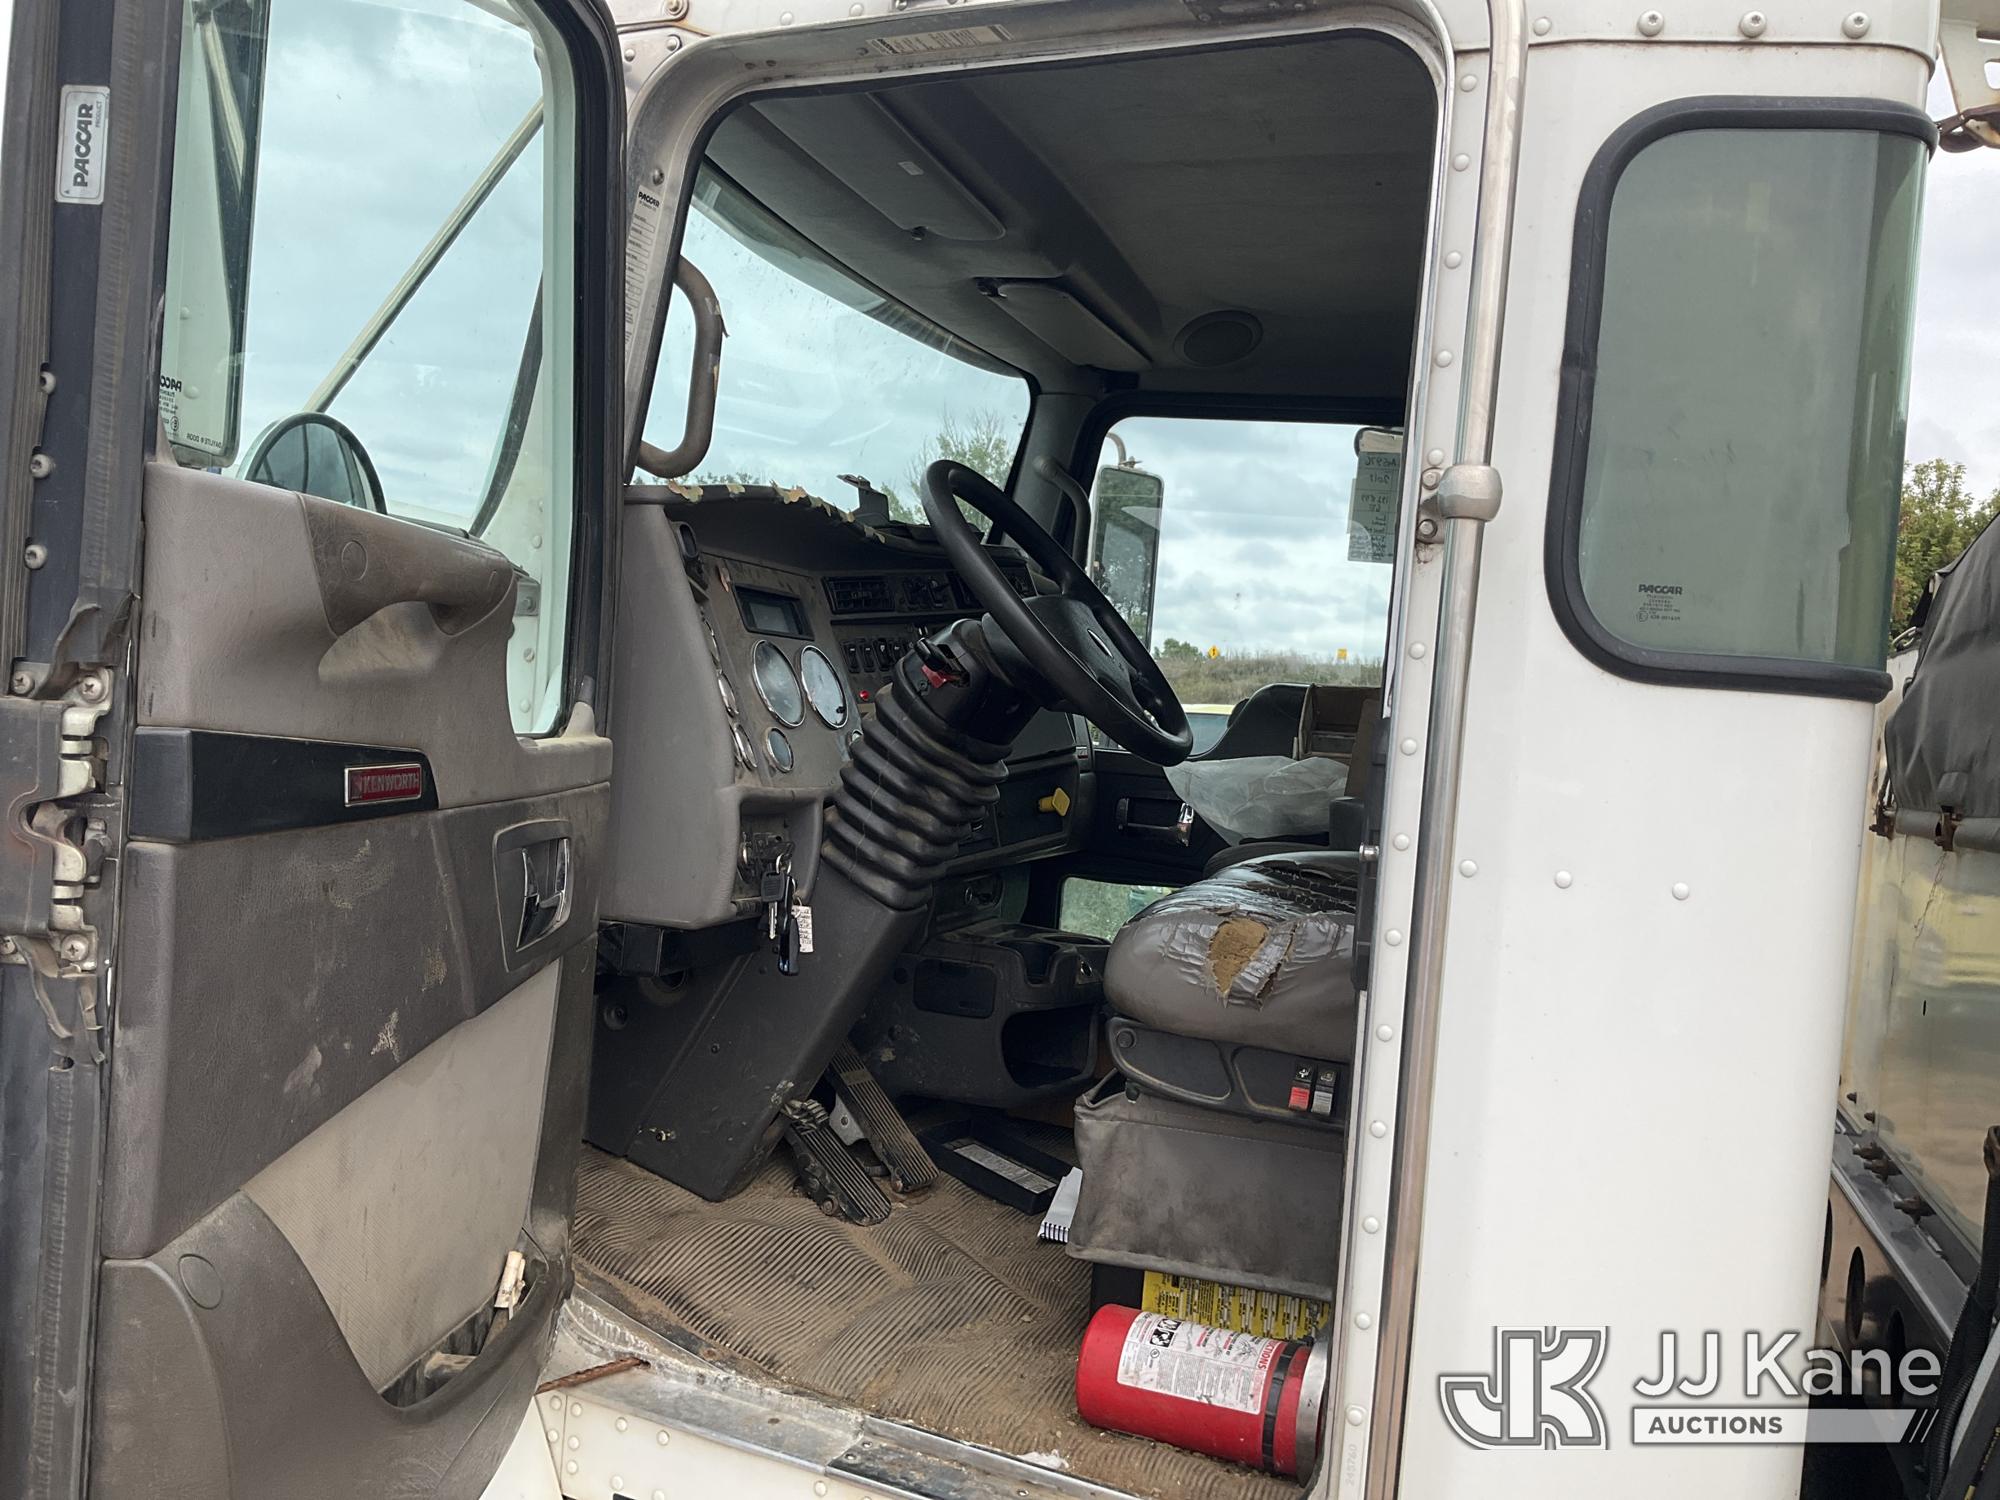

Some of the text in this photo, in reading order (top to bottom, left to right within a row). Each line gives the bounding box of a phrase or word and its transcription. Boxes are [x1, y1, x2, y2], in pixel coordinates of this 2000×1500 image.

[73, 103, 93, 187] PACCAR
[1638, 584, 1683, 595] PACCAR
[363, 772, 419, 794] KENWORTH
